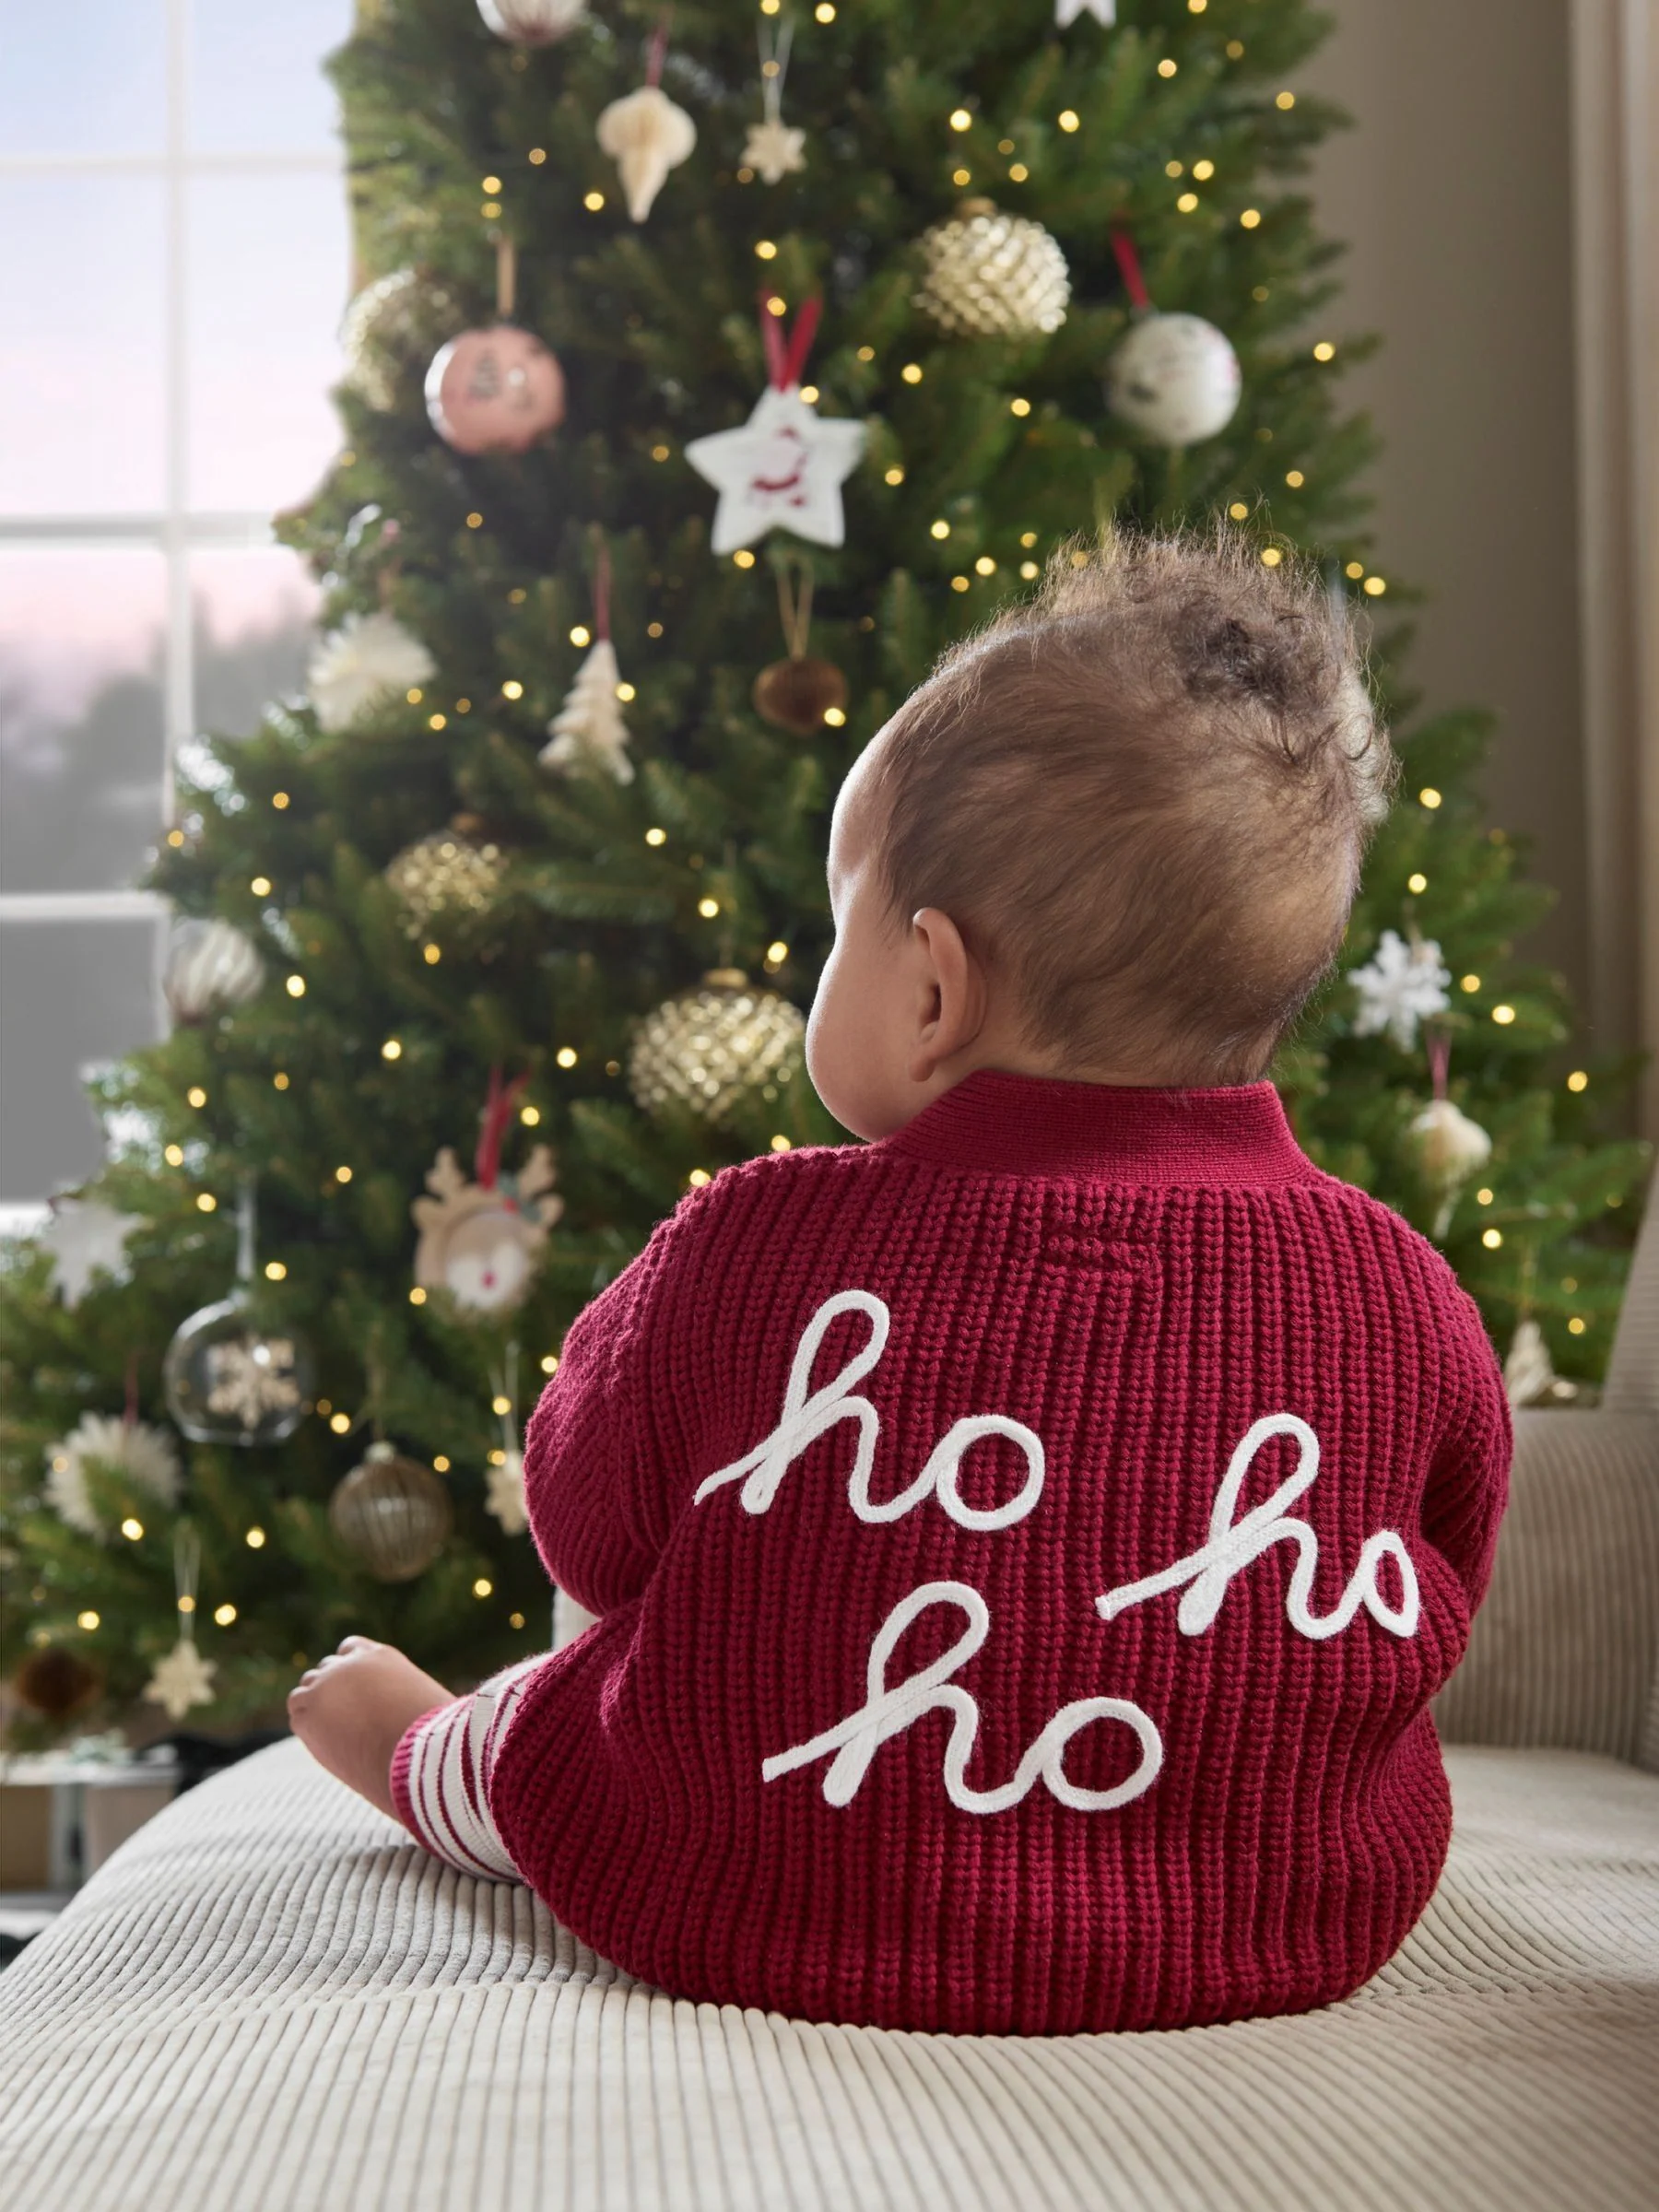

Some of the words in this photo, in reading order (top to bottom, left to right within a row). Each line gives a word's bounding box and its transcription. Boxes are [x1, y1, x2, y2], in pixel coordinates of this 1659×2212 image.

[693, 1288, 1045, 1532] ho
[1095, 1413, 1420, 1640] ho
[762, 1581, 1164, 1814] ho
